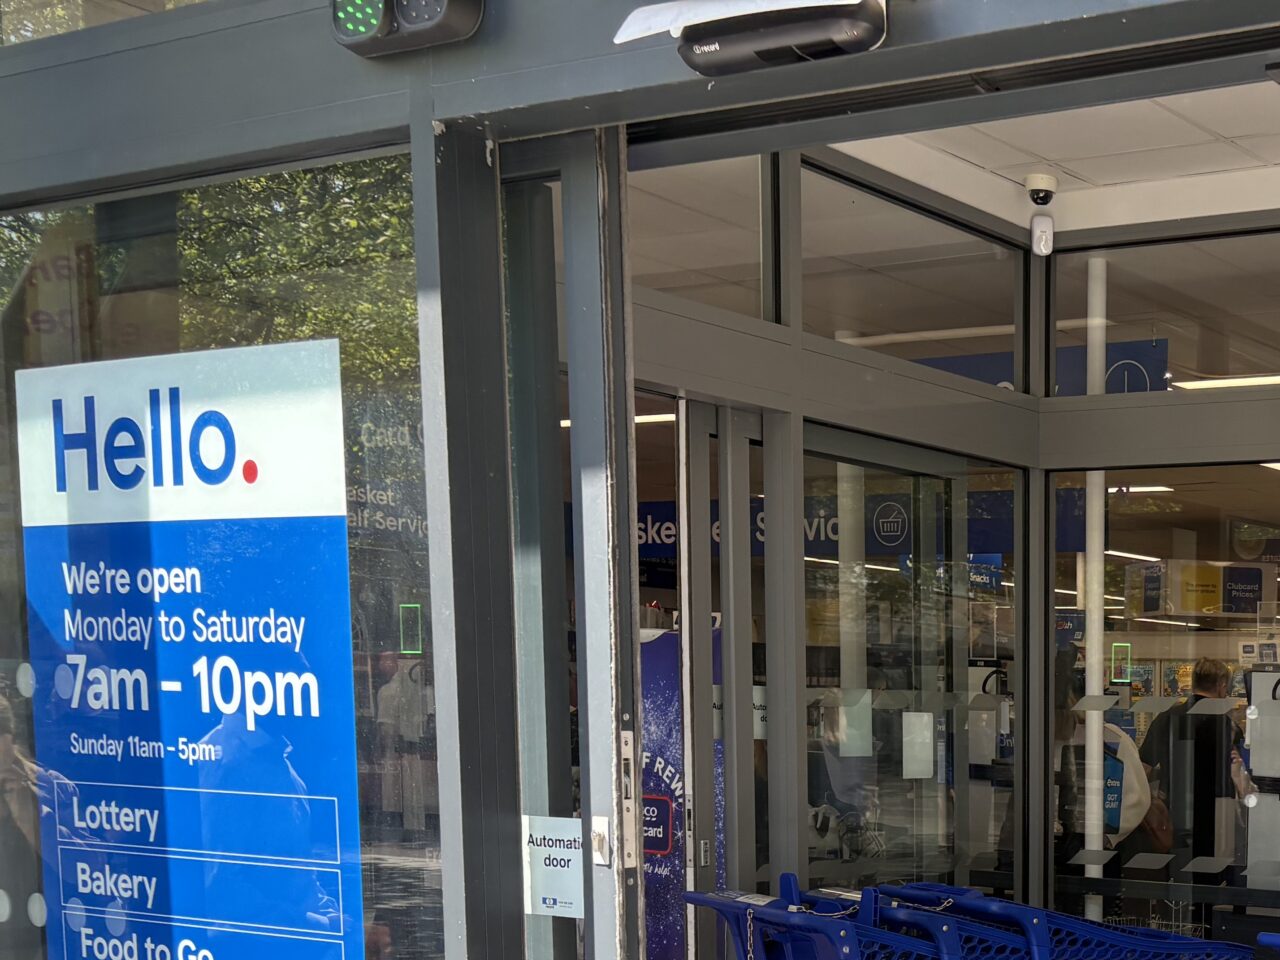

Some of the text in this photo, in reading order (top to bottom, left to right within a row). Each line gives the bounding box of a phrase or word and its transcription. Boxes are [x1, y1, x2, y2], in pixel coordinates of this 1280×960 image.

[51, 386, 258, 493] Hello.
[347, 484, 395, 506] asket
[347, 509, 428, 537] elf Servic
[61, 562, 201, 602] We're open
[970, 571, 990, 584] Snacks
[1227, 582, 1259, 592] Clubcard
[1231, 590, 1254, 599] Prices
[64, 608, 306, 652] Monday to Saturday
[66, 653, 150, 712] 7am
[192, 655, 321, 732] 10pm
[70, 732, 123, 762] Sunday
[127, 736, 164, 758] 11am
[72, 796, 160, 842] Lottery
[544, 854, 572, 869] door
[76, 862, 157, 909] Bakery
